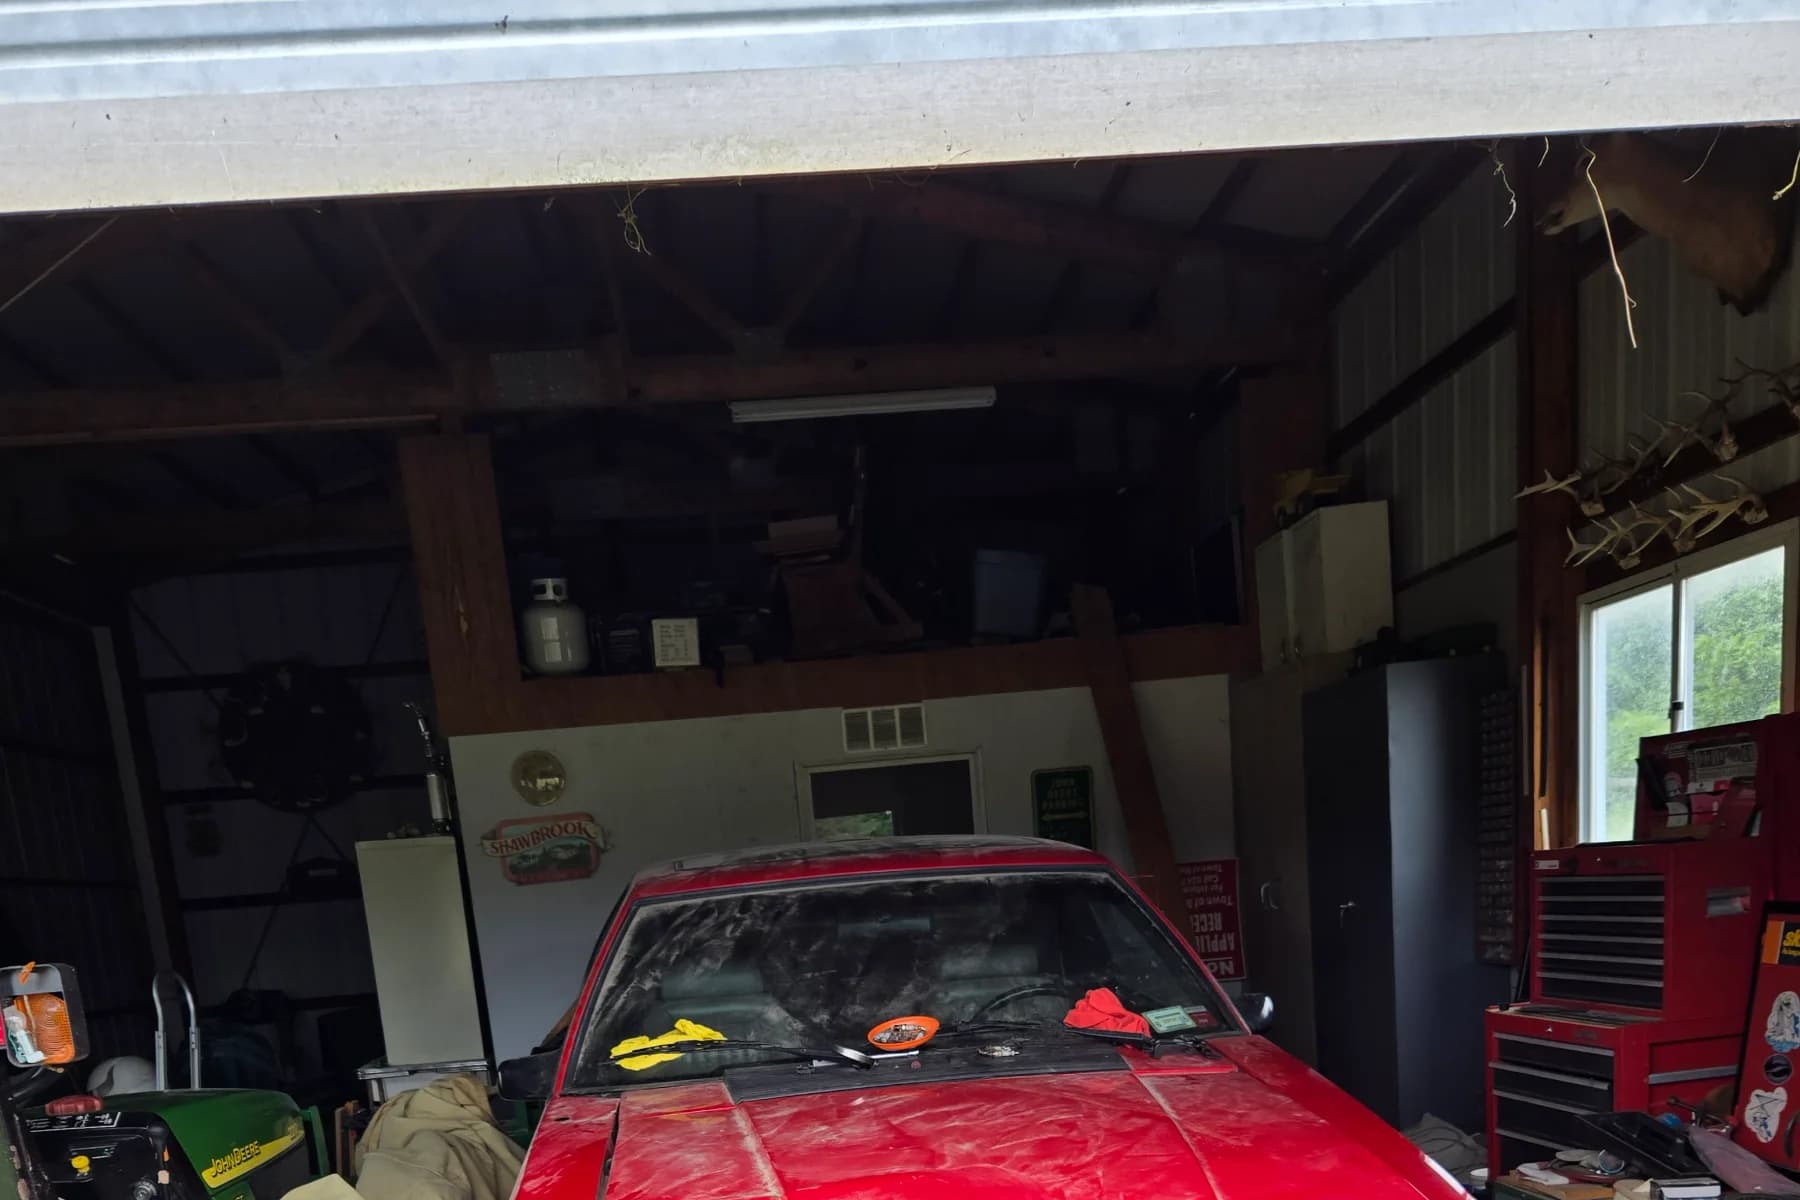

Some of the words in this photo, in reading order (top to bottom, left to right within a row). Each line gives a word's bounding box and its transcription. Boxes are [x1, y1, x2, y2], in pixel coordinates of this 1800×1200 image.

[489, 821, 597, 855] SHAWBROOK
[210, 1153, 237, 1178] JOHN
[232, 1140, 262, 1166] DEERE
